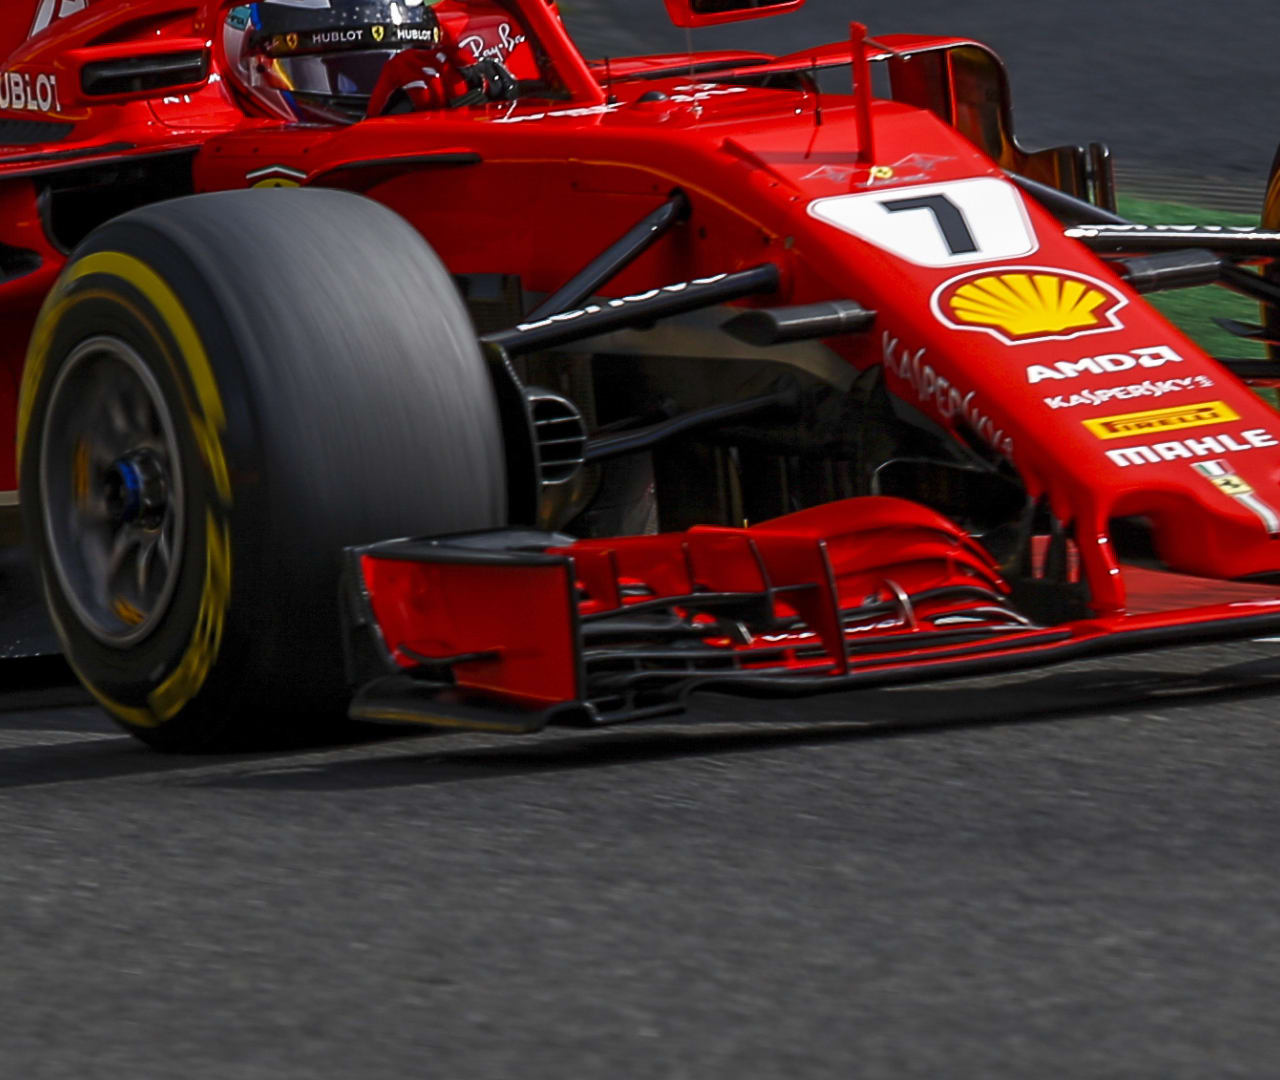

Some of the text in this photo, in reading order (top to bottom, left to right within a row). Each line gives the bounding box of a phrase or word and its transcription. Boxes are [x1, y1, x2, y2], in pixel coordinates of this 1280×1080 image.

[312, 30, 364, 44] HUBLOT
[397, 28, 432, 41] HUBLOT
[458, 23, 525, 62] Ray-Ba
[877, 193, 979, 256] 7
[1026, 353, 1138, 384] AMD
[1043, 380, 1193, 410] KASPERSKY
[1100, 406, 1222, 434] PIRELLI
[1104, 429, 1280, 468] MAHLE
